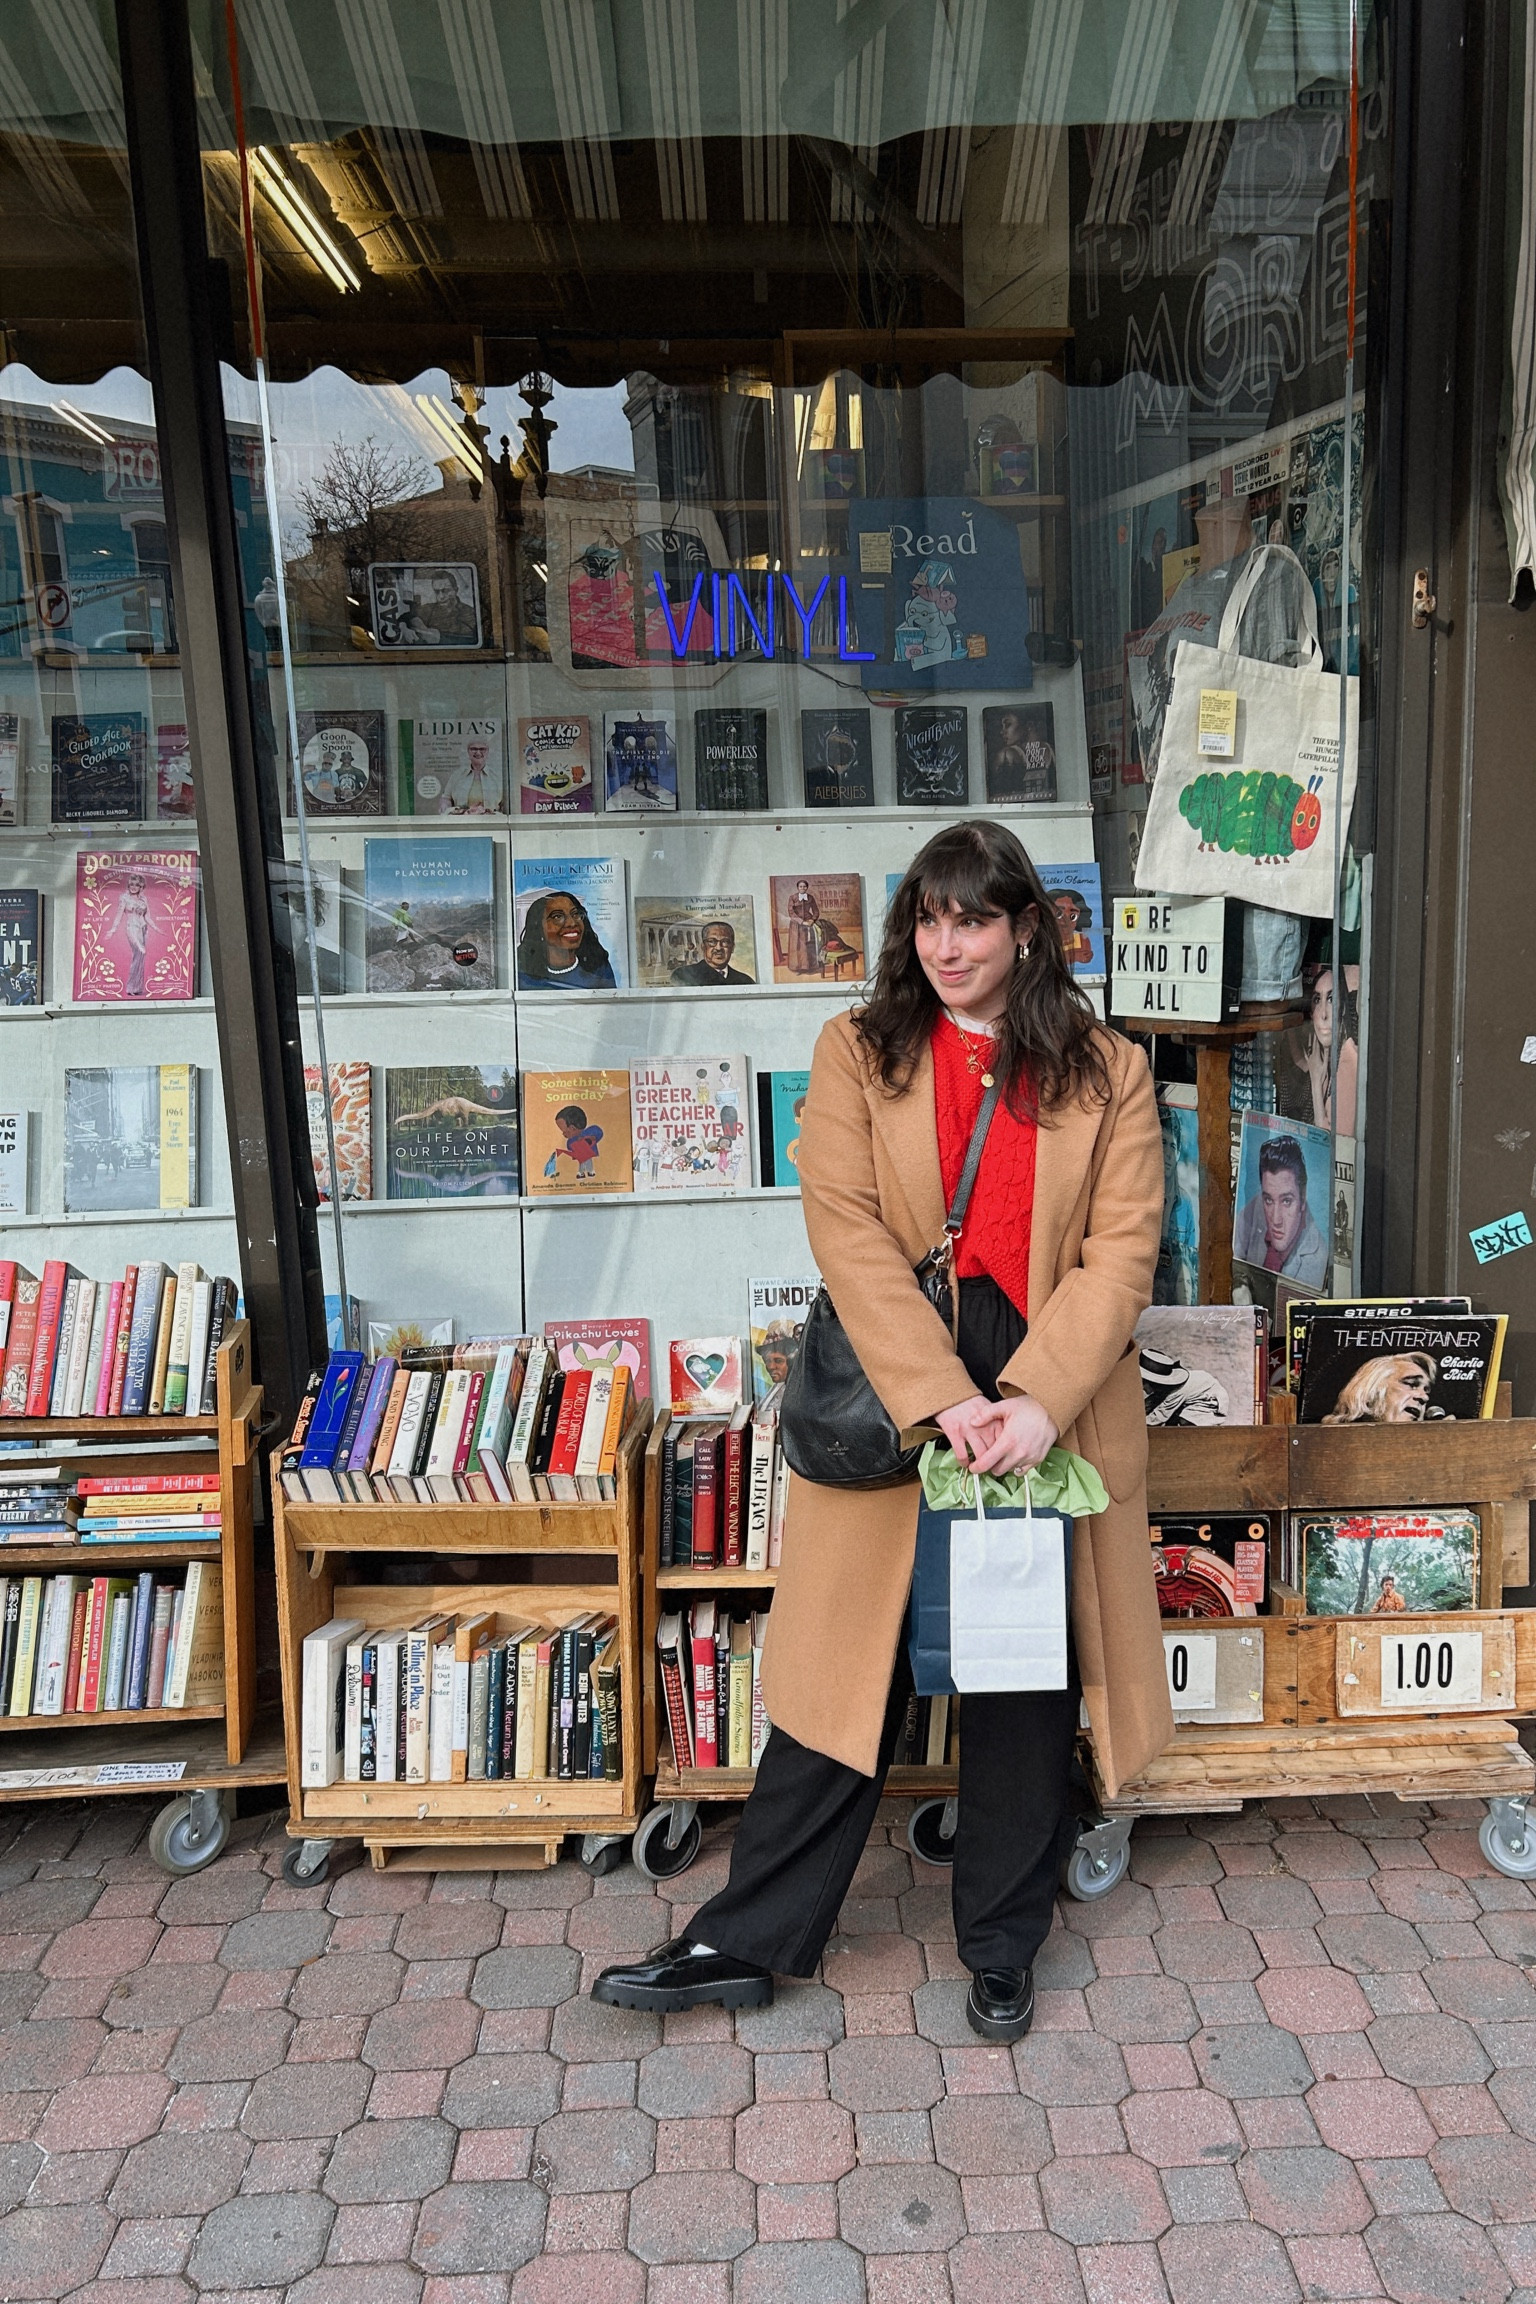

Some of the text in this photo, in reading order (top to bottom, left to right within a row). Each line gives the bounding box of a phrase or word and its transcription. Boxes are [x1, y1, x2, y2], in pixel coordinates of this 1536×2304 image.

[1116, 175, 1374, 452] MORE
[1234, 446, 1285, 471] RECORDED LIVE
[1235, 486, 1246, 495] THE
[1254, 476, 1272, 488] YEAR
[1273, 470, 1286, 480] OLD
[888, 518, 979, 559] Read
[376, 568, 403, 643] CASH
[653, 570, 876, 661] VINYL
[320, 732, 347, 741] Goon
[418, 721, 496, 736] LIDIA'S
[527, 724, 555, 740] CAT
[68, 729, 121, 754] GILDED AGE
[322, 743, 352, 751] Spoon
[706, 745, 758, 760] POWERLESS
[1312, 736, 1340, 747] THE VER
[1315, 746, 1340, 755] HUNGR
[80, 740, 132, 769] COOKBOOK
[814, 785, 867, 800] ALEBRIJES
[535, 802, 554, 812] DAV
[84, 854, 192, 874] DOLLY PARTON
[394, 868, 470, 878] PLAYGROUND
[522, 863, 615, 876] JUSTICE KETANJI
[1064, 875, 1096, 885] Obama
[685, 904, 716, 912] Thurgood
[820, 900, 850, 909] TUBMAN
[1117, 944, 1208, 974] KIND TO
[1143, 982, 1180, 1012] ALL
[541, 1077, 613, 1090] Something,
[634, 1070, 672, 1086] LILA
[635, 1088, 696, 1104] GREER,
[165, 1108, 183, 1116] 1964
[635, 1105, 716, 1122] TEACHER
[417, 1131, 489, 1144] LIFE ON
[636, 1122, 744, 1140] OF THE YEAR
[395, 1144, 509, 1158] OUR PLANET
[41, 1286, 58, 1327] DEAVER
[84, 1289, 93, 1303] The
[754, 1288, 764, 1308] THE
[15, 1310, 37, 1318] PETER
[59, 1284, 76, 1356] ROPE-DANCER
[1344, 1307, 1413, 1318] STEREO
[103, 1308, 116, 1364] WEDDING PARTIES
[174, 1296, 189, 1361] LEAVING HOME
[554, 1329, 640, 1340] Pikachu Loves
[1334, 1329, 1481, 1348] THE ENTERTAINER
[127, 1345, 138, 1378] CELLAR
[206, 1317, 222, 1383] PAT BARKER
[1440, 1355, 1485, 1369] Charlie
[31, 1335, 50, 1397] BURNING WIRE
[133, 1349, 146, 1391] COUNTRY
[1443, 1369, 1476, 1381] Rich
[380, 1389, 401, 1447] AN END TO DYING
[556, 1398, 573, 1435] LEONA BLAIR
[565, 1388, 588, 1453] WORLD DIFFERENCE
[606, 1429, 617, 1454] MANGO
[663, 1440, 674, 1547] THE YEAR OF SILENCE BELL
[727, 1433, 740, 1550] BETHELL THE ELECTRIC WINDMILL
[752, 1453, 769, 1534] The LEGACY
[1374, 1528, 1444, 1538] HAMMOND
[1413, 1517, 1430, 1528] OF
[182, 1563, 200, 1646] VERSES VERSIONS
[93, 1609, 102, 1633] NORTON
[189, 1669, 223, 1681] NABOKOV
[408, 1639, 426, 1710] Falling in Place
[562, 1633, 571, 1697] THOMAS BERGER
[704, 1665, 714, 1690] ALLEN
[1397, 1642, 1453, 1690] 1.00
[347, 1664, 362, 1707] Delirium
[696, 1664, 705, 1692] DRURY
[474, 1686, 484, 1705] have
[503, 1644, 516, 1760] ALICE ADAMS Return Trips
[577, 1673, 588, 1723] DEAD RITES
[606, 1691, 617, 1745] NOW LAY ME
[697, 1700, 705, 1738] OF EARTH
[706, 1698, 715, 1744] THE ROADS
[732, 1678, 744, 1753] Grandfather Stories
[753, 1677, 765, 1750] watchfires
[905, 1690, 918, 1742] WARLORD
[591, 1752, 602, 1768] Gift
